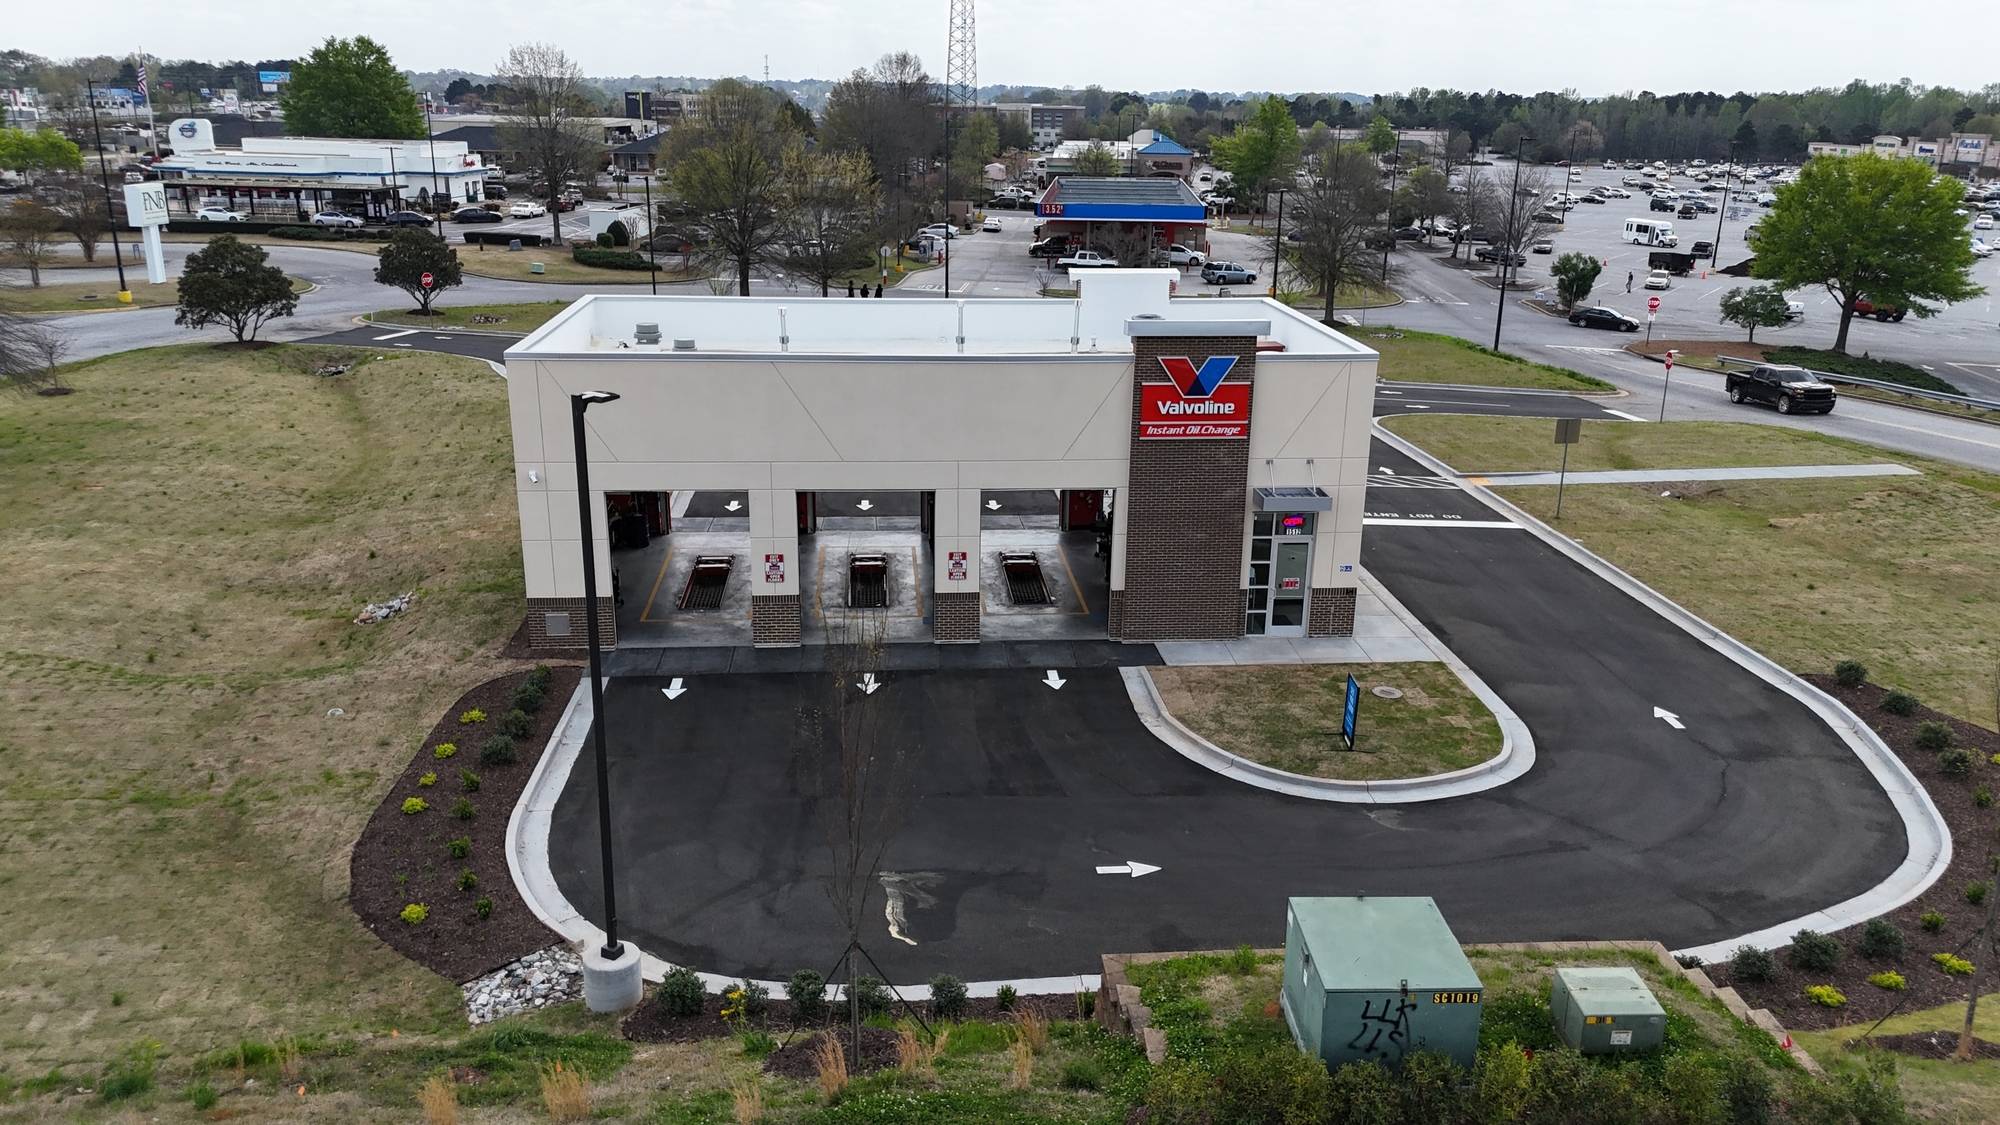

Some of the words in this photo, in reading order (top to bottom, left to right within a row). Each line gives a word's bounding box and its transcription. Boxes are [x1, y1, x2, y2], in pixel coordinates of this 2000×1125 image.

[142, 191, 165, 211] FNB
[1157, 400, 1235, 415] Valvoline
[1147, 426, 1185, 435] Instant
[1186, 425, 1200, 434] Oil
[1201, 425, 1241, 436] Change
[1283, 517, 1303, 526] OPEN
[1433, 993, 1479, 1003] SC1019
